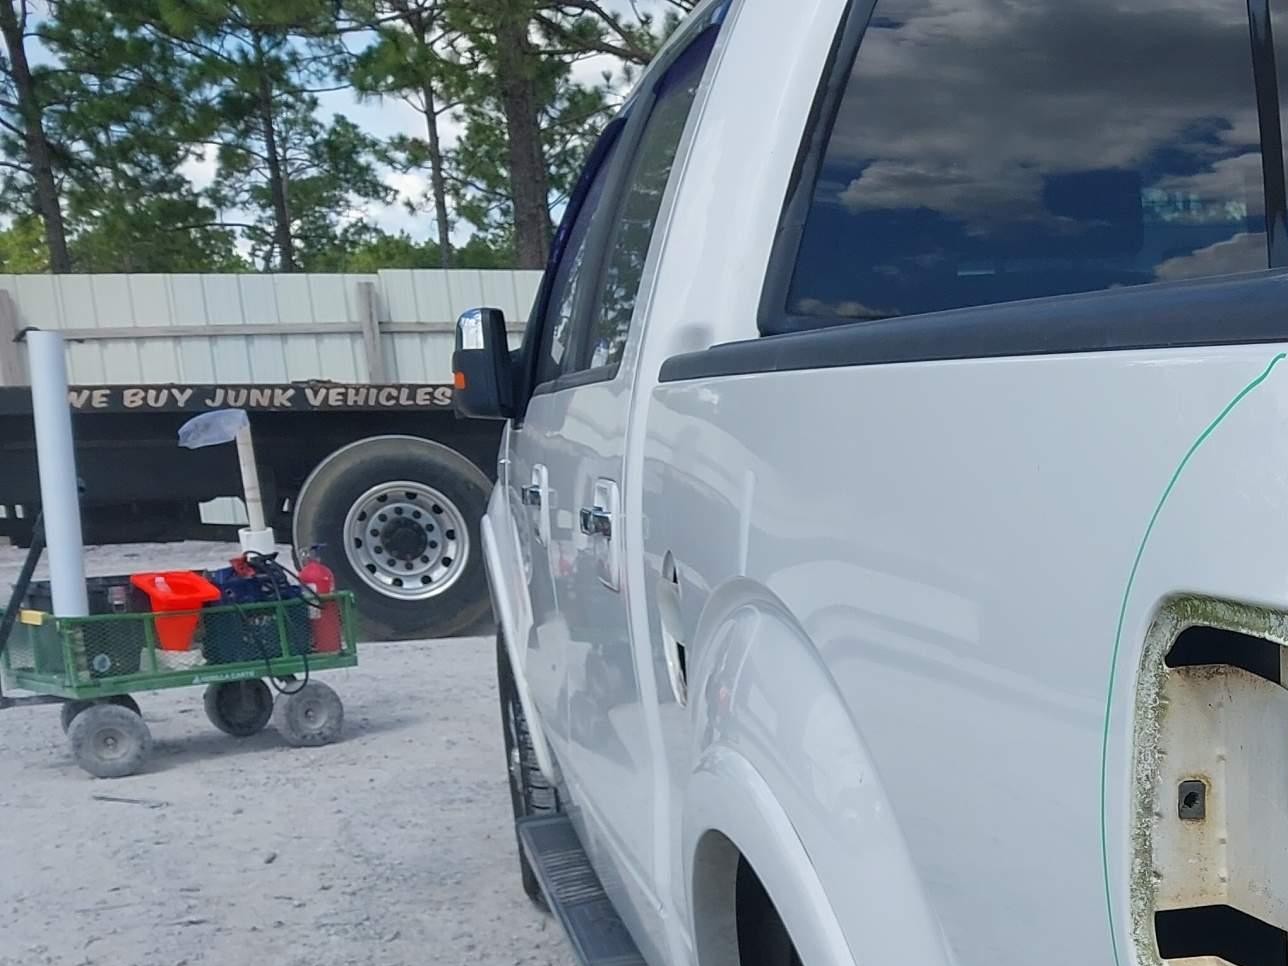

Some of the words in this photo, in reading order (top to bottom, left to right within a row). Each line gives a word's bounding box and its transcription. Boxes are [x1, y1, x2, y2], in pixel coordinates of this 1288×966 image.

[68, 389, 111, 408] WE
[122, 388, 193, 408] BUY
[205, 388, 296, 408] JUNK
[305, 387, 452, 406] VEHICLES
